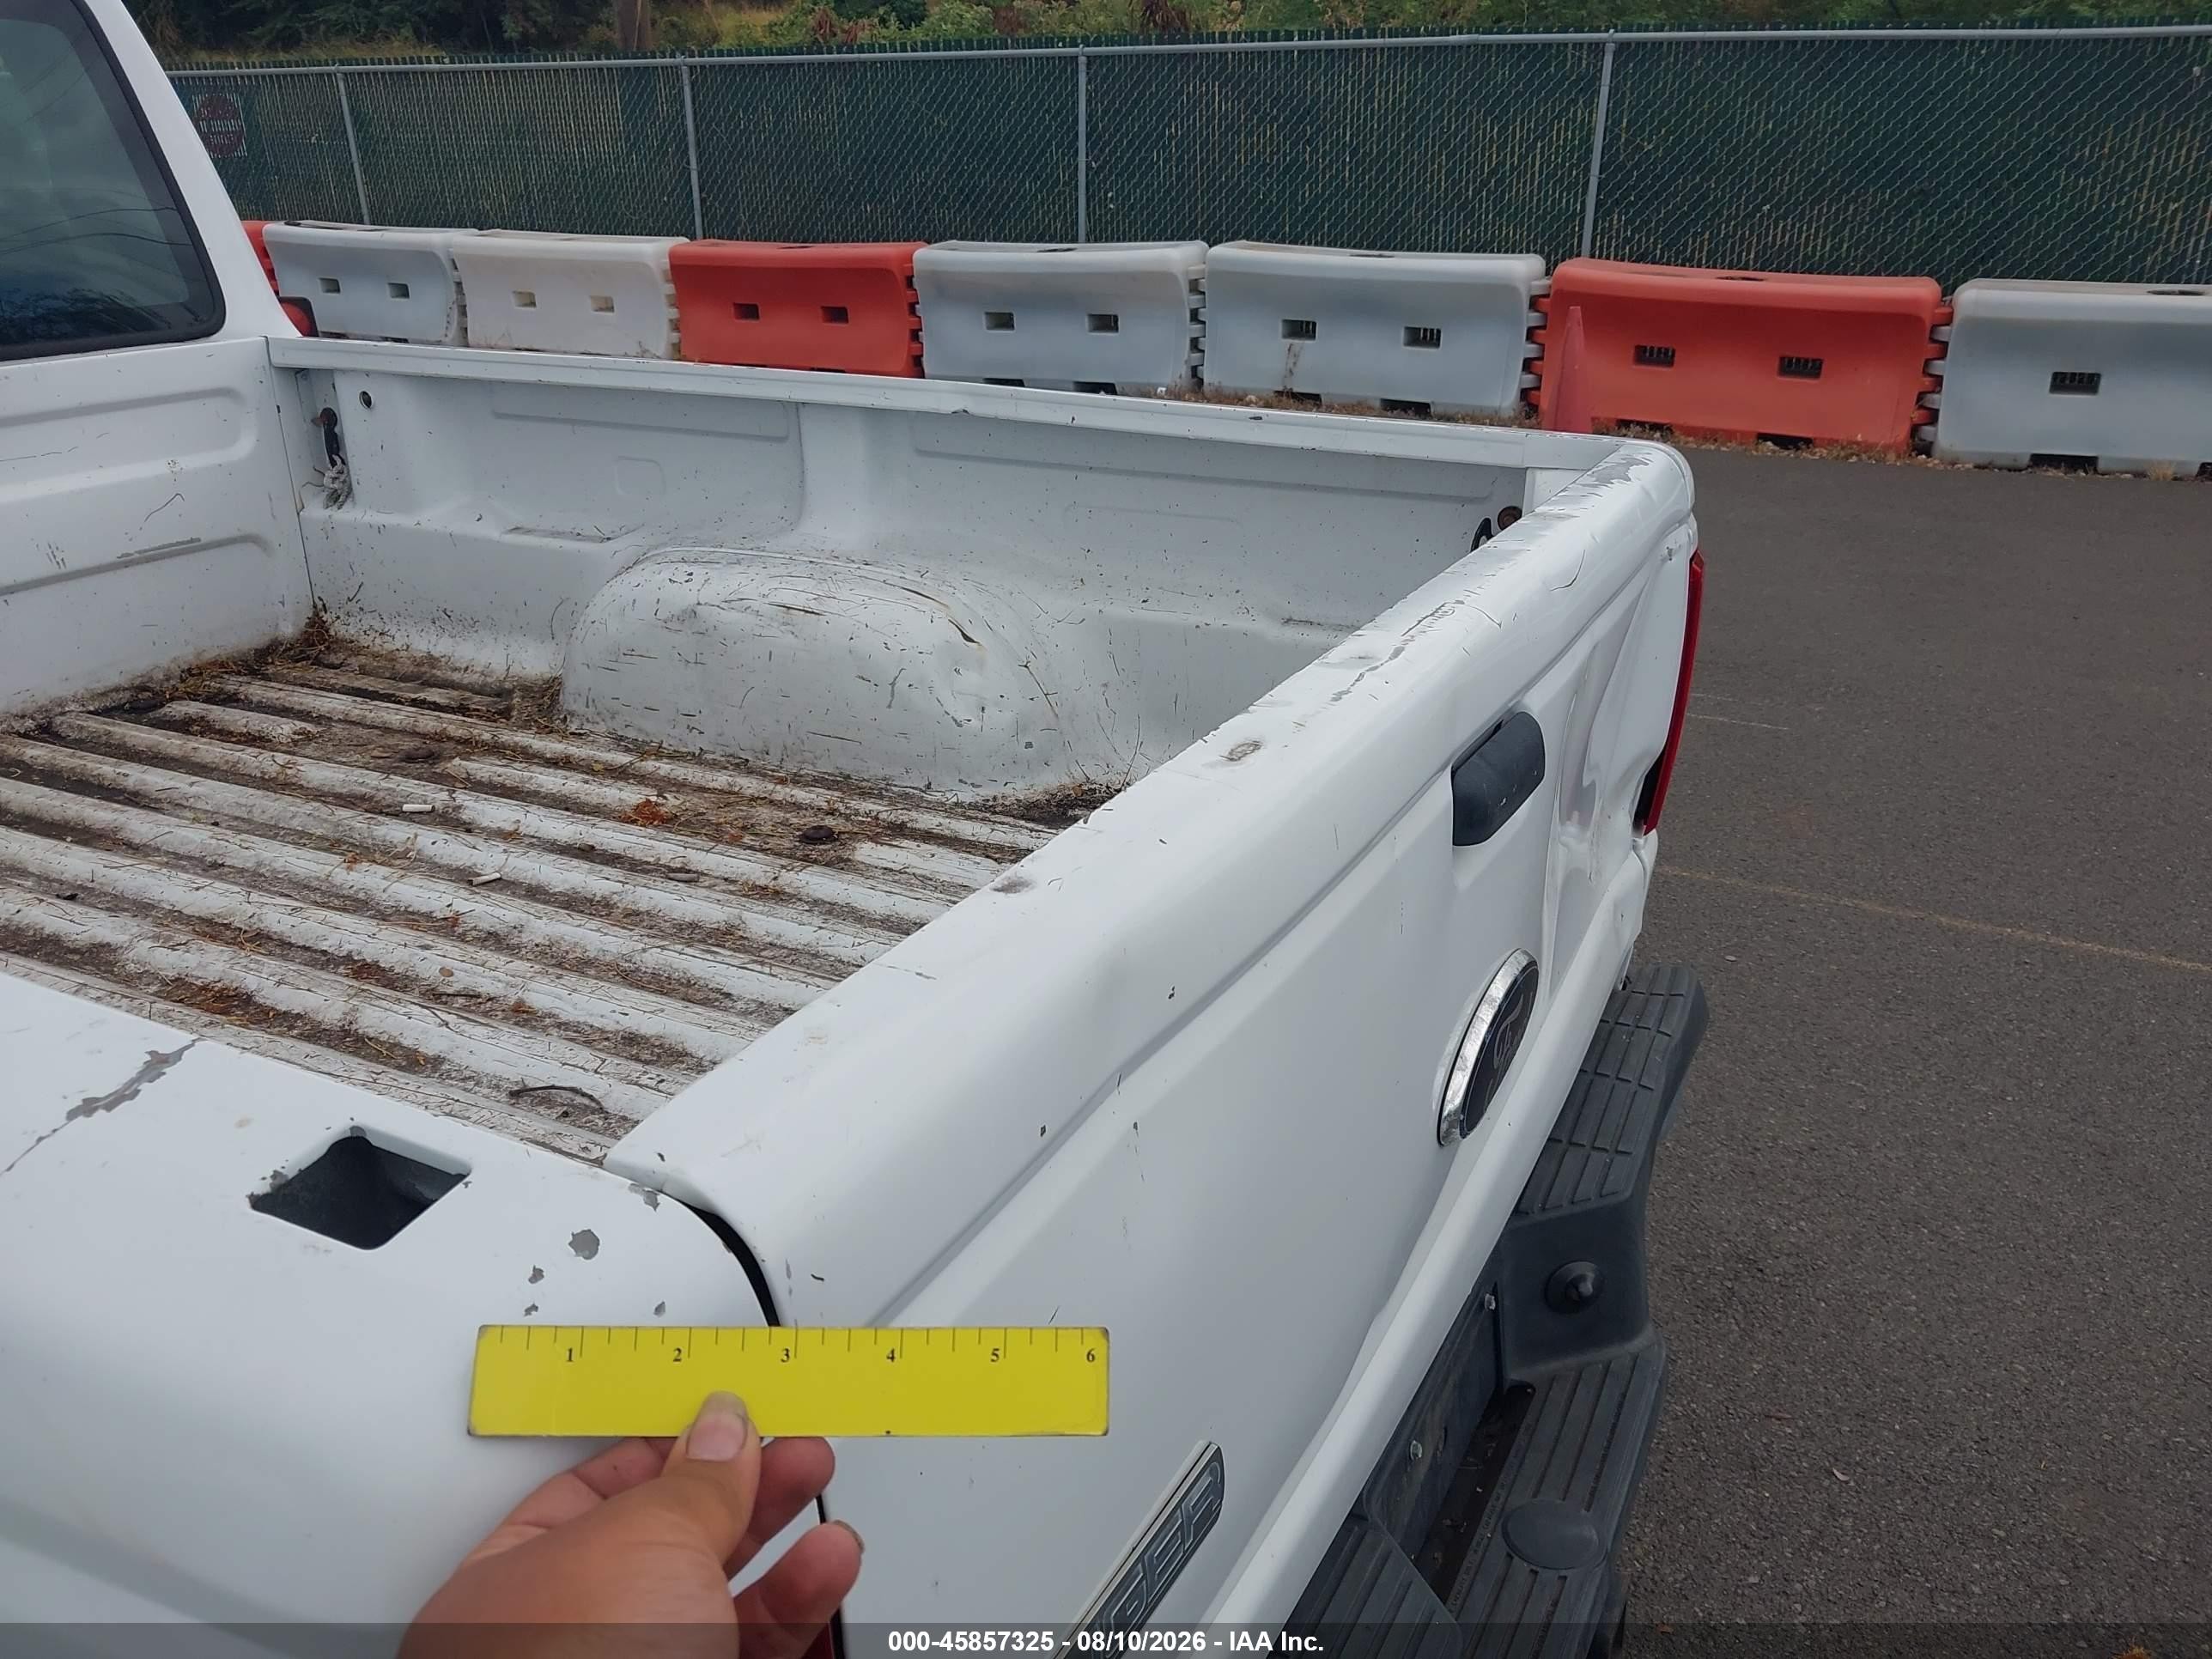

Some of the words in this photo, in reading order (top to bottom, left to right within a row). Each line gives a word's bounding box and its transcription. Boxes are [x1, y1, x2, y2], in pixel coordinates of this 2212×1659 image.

[566, 1347, 574, 1363] 1
[673, 1347, 683, 1363] 2
[781, 1347, 790, 1364] 3
[885, 1348, 896, 1364] 4
[990, 1347, 1000, 1363] 5
[1085, 1348, 1097, 1364] 6
